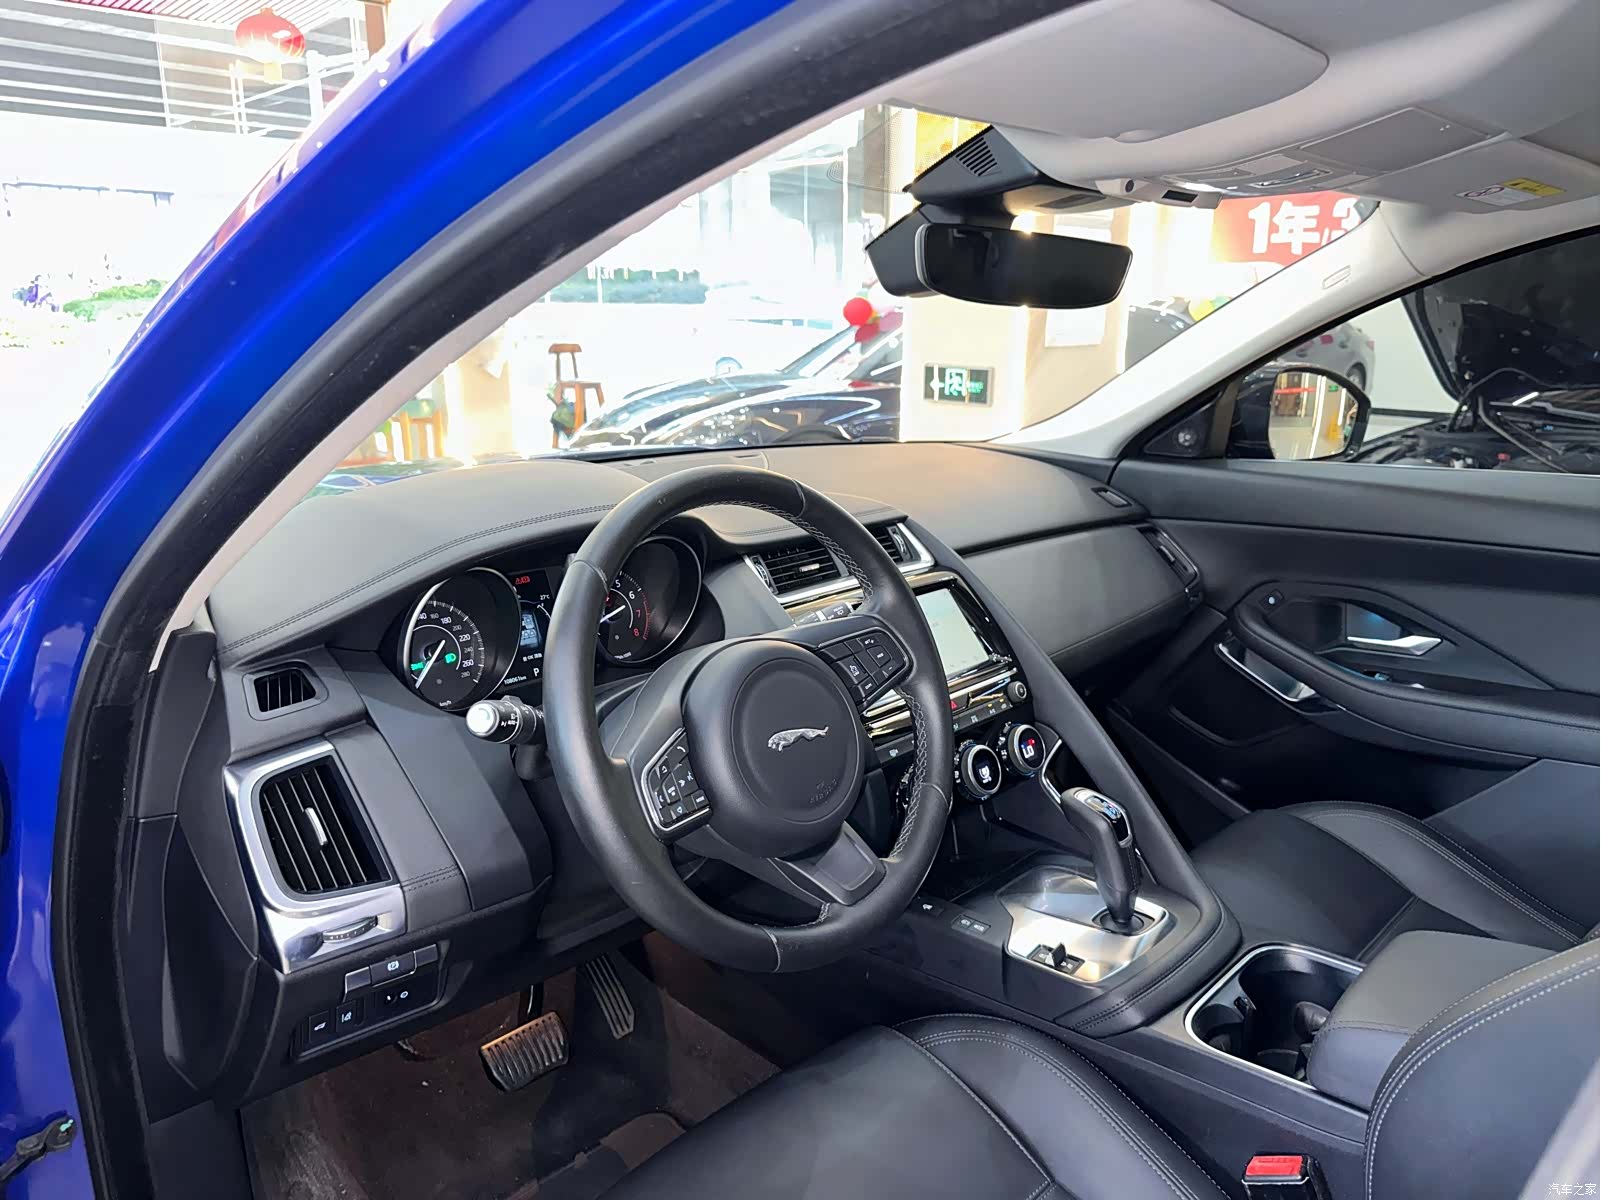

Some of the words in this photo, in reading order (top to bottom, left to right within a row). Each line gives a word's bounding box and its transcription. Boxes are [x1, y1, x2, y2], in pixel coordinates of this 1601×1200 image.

[615, 579, 621, 588] 5
[628, 590, 635, 600] 6
[635, 609, 641, 618] 7
[440, 616, 452, 625] 180
[633, 628, 640, 637] 8
[459, 633, 471, 642] 220
[462, 659, 475, 668] 260
[533, 667, 540, 677] P
